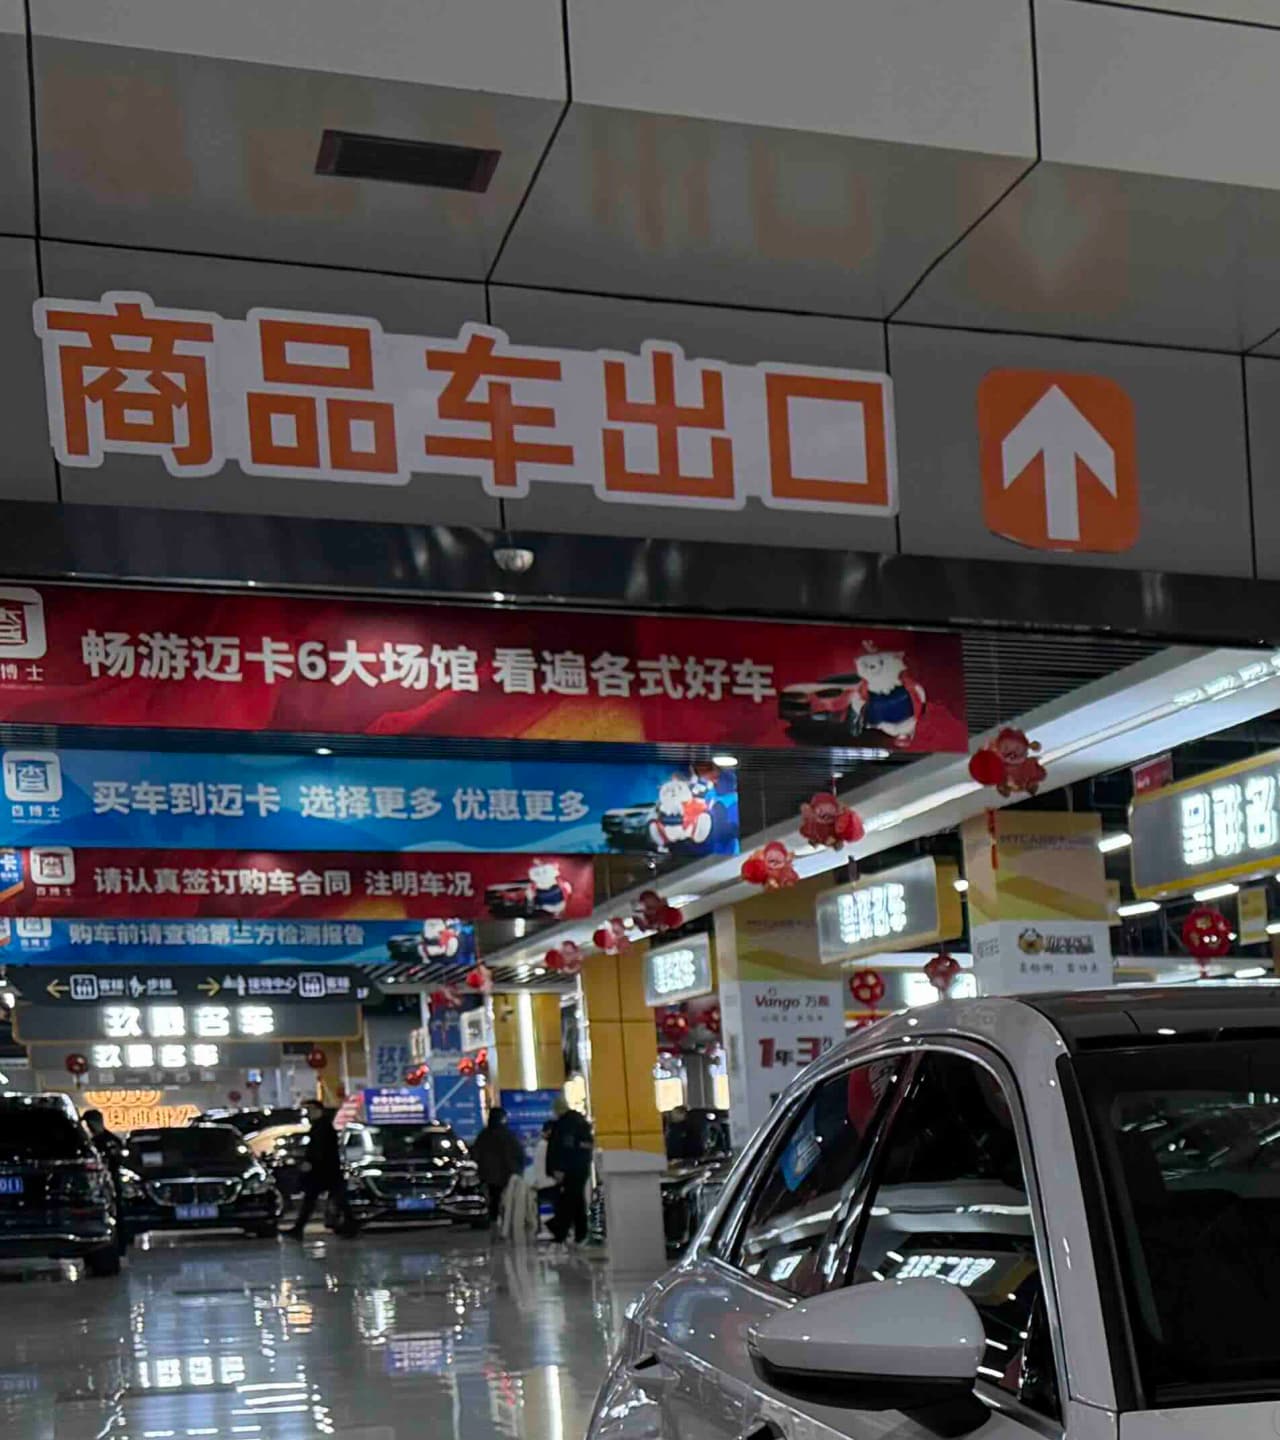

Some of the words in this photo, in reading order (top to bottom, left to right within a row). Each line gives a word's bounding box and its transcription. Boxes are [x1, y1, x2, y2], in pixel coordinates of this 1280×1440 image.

[44, 300, 892, 509] 商品车出口
[81, 628, 480, 692] 畅游迈卡6大场馆
[493, 646, 777, 704] 看遍各式好车
[93, 780, 281, 817] 买车到迈卡
[299, 784, 442, 820] 选择更多
[452, 787, 590, 823] 优惠更多
[93, 866, 351, 897] 请认真签订购车合同
[364, 869, 474, 898] 注明车况
